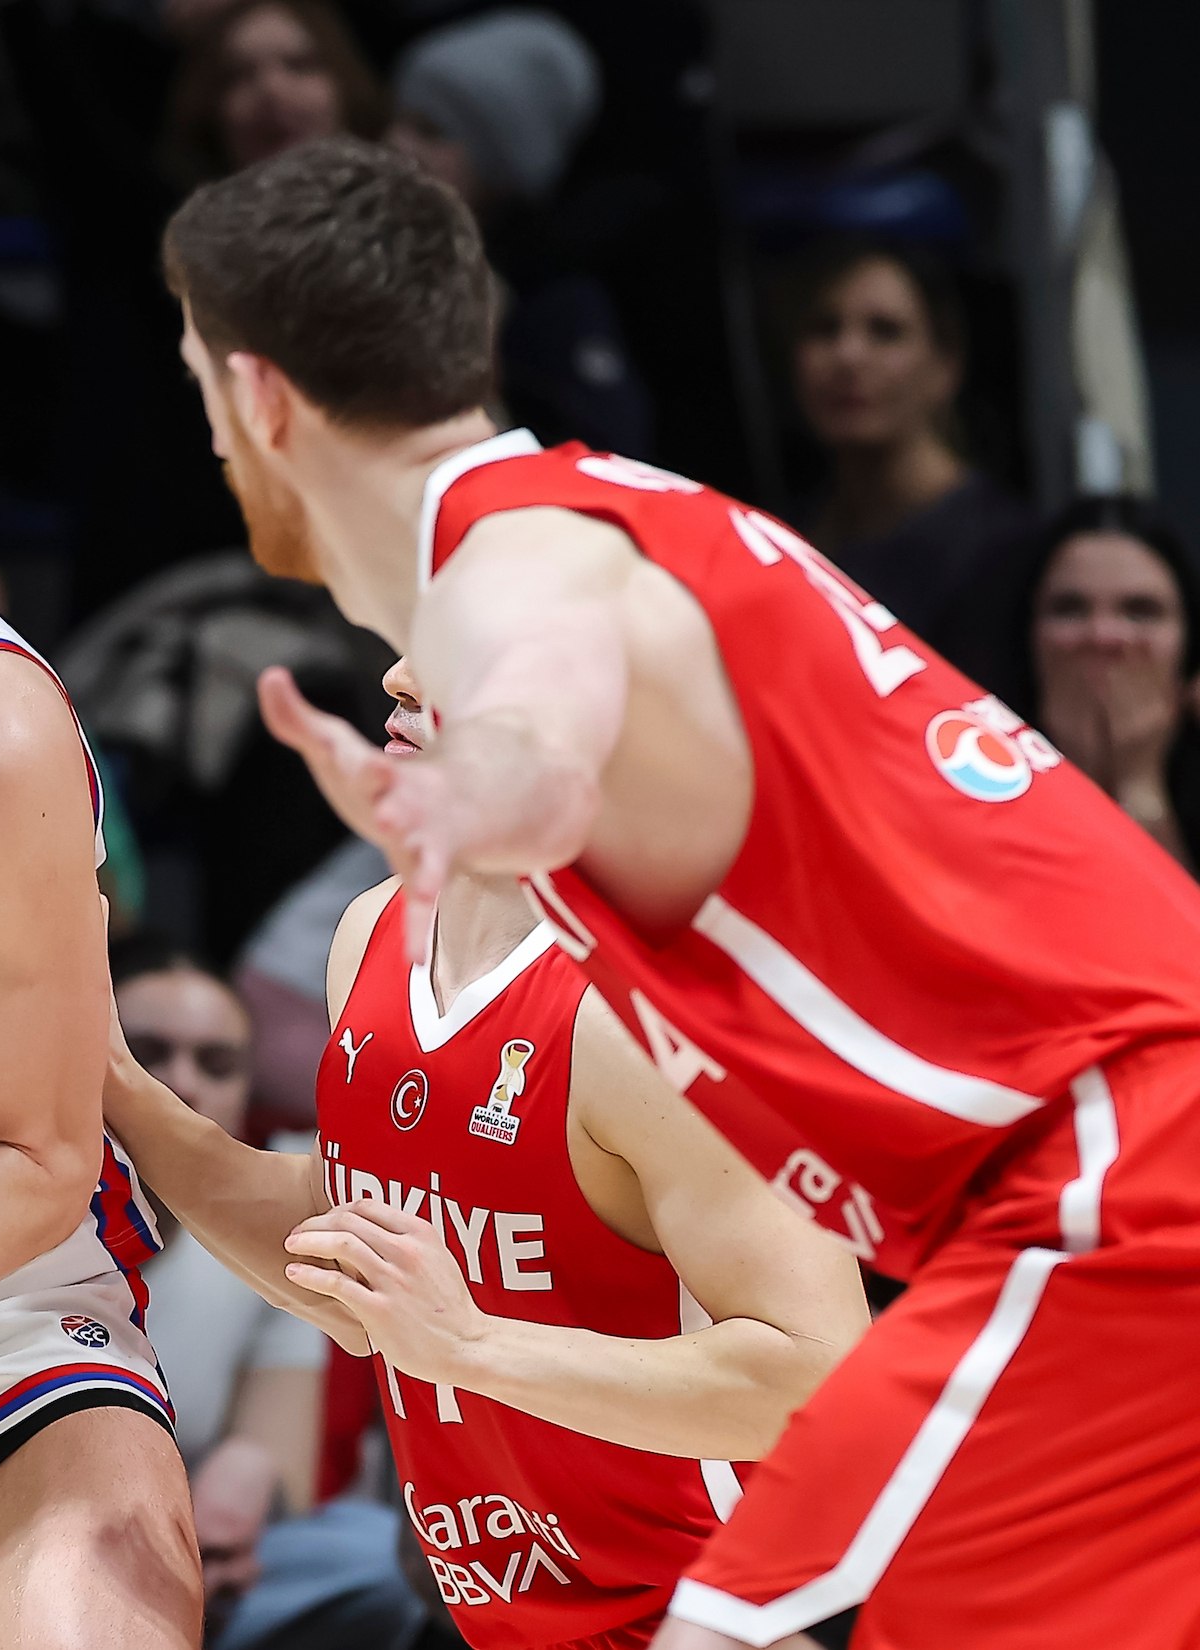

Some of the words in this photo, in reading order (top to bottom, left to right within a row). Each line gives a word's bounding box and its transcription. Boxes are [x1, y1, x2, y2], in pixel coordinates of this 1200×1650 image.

[471, 1121, 514, 1142] QUALIFIERS
[474, 1113, 500, 1127] WORLD
[500, 1121, 517, 1131] CUP
[426, 1541, 572, 1606] BBVA
